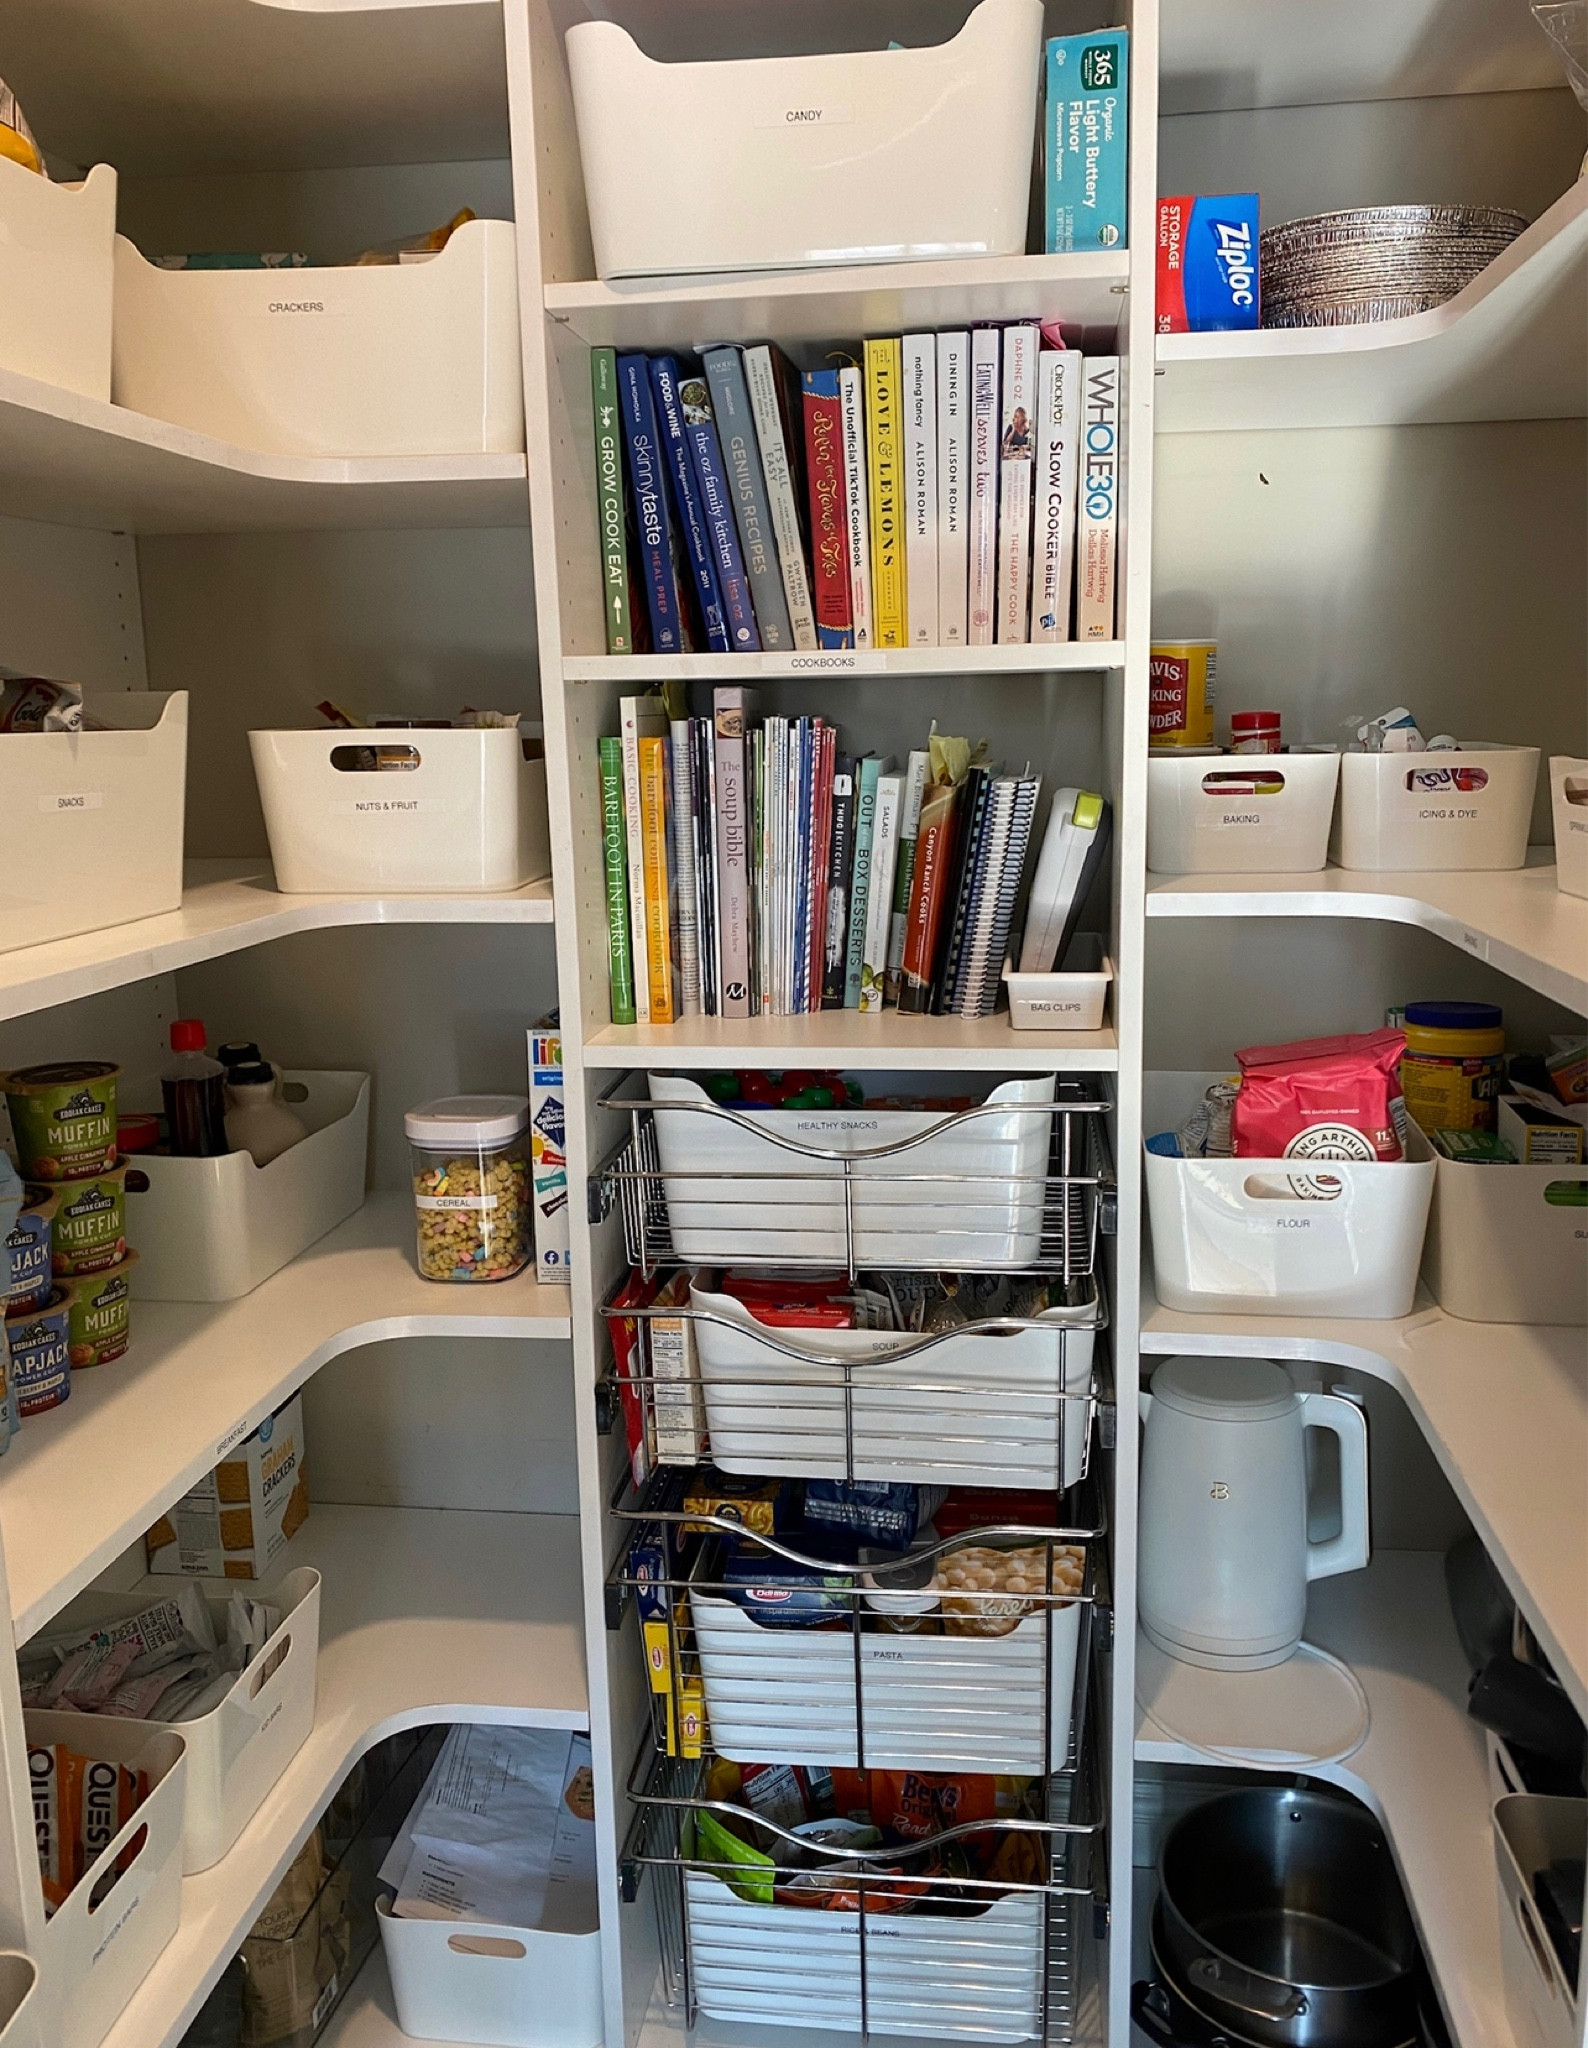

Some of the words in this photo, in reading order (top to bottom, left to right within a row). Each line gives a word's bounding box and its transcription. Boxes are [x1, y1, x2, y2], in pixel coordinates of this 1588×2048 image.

[1094, 50, 1113, 85] 365
[786, 110, 822, 122] CANDY
[1069, 101, 1083, 154] Flavor
[1083, 100, 1100, 143] Light
[1101, 97, 1117, 142] Organic
[1082, 146, 1100, 208] Buttery
[1160, 205, 1168, 247] GALLON
[1168, 205, 1181, 270] STORAGE
[1216, 222, 1255, 306] Ziploc
[268, 301, 324, 314] CRACKERS
[914, 356, 924, 396] nothing
[949, 353, 957, 399] DINING
[1014, 338, 1023, 381] DAPHNE
[845, 383, 853, 403] The
[877, 371, 890, 435] LOVE
[949, 403, 957, 416] IN
[1014, 385, 1023, 400] OZ
[914, 396, 924, 428] fancy
[696, 432, 709, 455] the
[773, 442, 785, 463] IT'S
[845, 407, 857, 463] Unofficial
[878, 441, 893, 458] &
[1086, 369, 1115, 520] WHOLE30
[601, 436, 617, 492] GROW
[701, 457, 711, 474] oz
[766, 453, 778, 482] EASY
[777, 468, 788, 489] ALL
[916, 442, 925, 487] ALISON
[1049, 441, 1064, 488] SLOW
[633, 434, 662, 545] skinnytaste
[704, 476, 723, 518] family
[850, 467, 859, 506] TikTok
[604, 498, 619, 548] COOK
[731, 437, 753, 500] GENIUS
[742, 506, 767, 574] RECIPES
[879, 464, 894, 566] LEMONS
[918, 492, 926, 535] ROMAN
[715, 520, 732, 568] kitchen
[851, 509, 862, 566] Cookbook
[1010, 534, 1019, 554] THE
[1046, 493, 1062, 560] COOKER
[1088, 529, 1096, 560] Dallas
[1101, 529, 1109, 565] Melissa
[608, 555, 622, 587] EAT
[652, 550, 663, 581] MEAL
[700, 570, 710, 588] 2011
[793, 560, 806, 606] GWYNETH
[1009, 556, 1018, 591] HAPPY
[1045, 563, 1058, 600] BIBLE
[1085, 560, 1096, 598] Hartwig
[657, 585, 668, 614] PREP
[727, 579, 739, 601] lisa
[733, 605, 743, 621] oz
[787, 564, 798, 606] PALTROW
[1097, 565, 1108, 603] Hartwig
[1009, 594, 1017, 625] COOK
[791, 657, 856, 668] COOKBOOKS
[626, 738, 635, 772] BASIC
[645, 748, 655, 767] the
[721, 761, 740, 772] The
[57, 797, 84, 808] SNACKS
[355, 801, 382, 811] NUTS
[383, 802, 390, 811] &
[392, 801, 419, 811] FRUIT
[627, 777, 638, 838] COOKING
[648, 775, 658, 836] barefoot
[721, 778, 738, 821] soup
[836, 803, 845, 829] THUG
[861, 795, 874, 828] OUT
[1419, 810, 1446, 819] ICING
[1447, 810, 1454, 818] &
[1457, 810, 1478, 818] DYE
[604, 777, 622, 876] BAREFOOT
[882, 806, 890, 839] SALADS
[1223, 814, 1260, 824] BAKING
[726, 825, 743, 867] bible
[833, 834, 843, 878] KITCHEN
[926, 827, 937, 862] Canyon
[650, 839, 659, 902] contessa
[856, 849, 869, 880] BOX
[922, 865, 933, 892] Ranch
[609, 882, 622, 902] IN
[730, 897, 738, 921] Debra
[850, 886, 867, 966] DESSERTS
[919, 896, 929, 924] Cooks
[610, 906, 625, 958] PARIS
[652, 905, 664, 974] cookbook
[48, 1117, 110, 1144] MUFFIN
[798, 1121, 838, 1130] HEALTHY
[841, 1121, 878, 1130] SNACKS
[1296, 1137, 1317, 1157] ING
[437, 1199, 470, 1207] CEREAL
[58, 1210, 120, 1240] MUFFIN
[1276, 1219, 1311, 1228] FLOUR
[872, 1342, 899, 1351] SOUP
[216, 1421, 247, 1455] BREAKFAST
[262, 1455, 296, 1497] CRACKERS
[873, 1651, 903, 1659] PASTA
